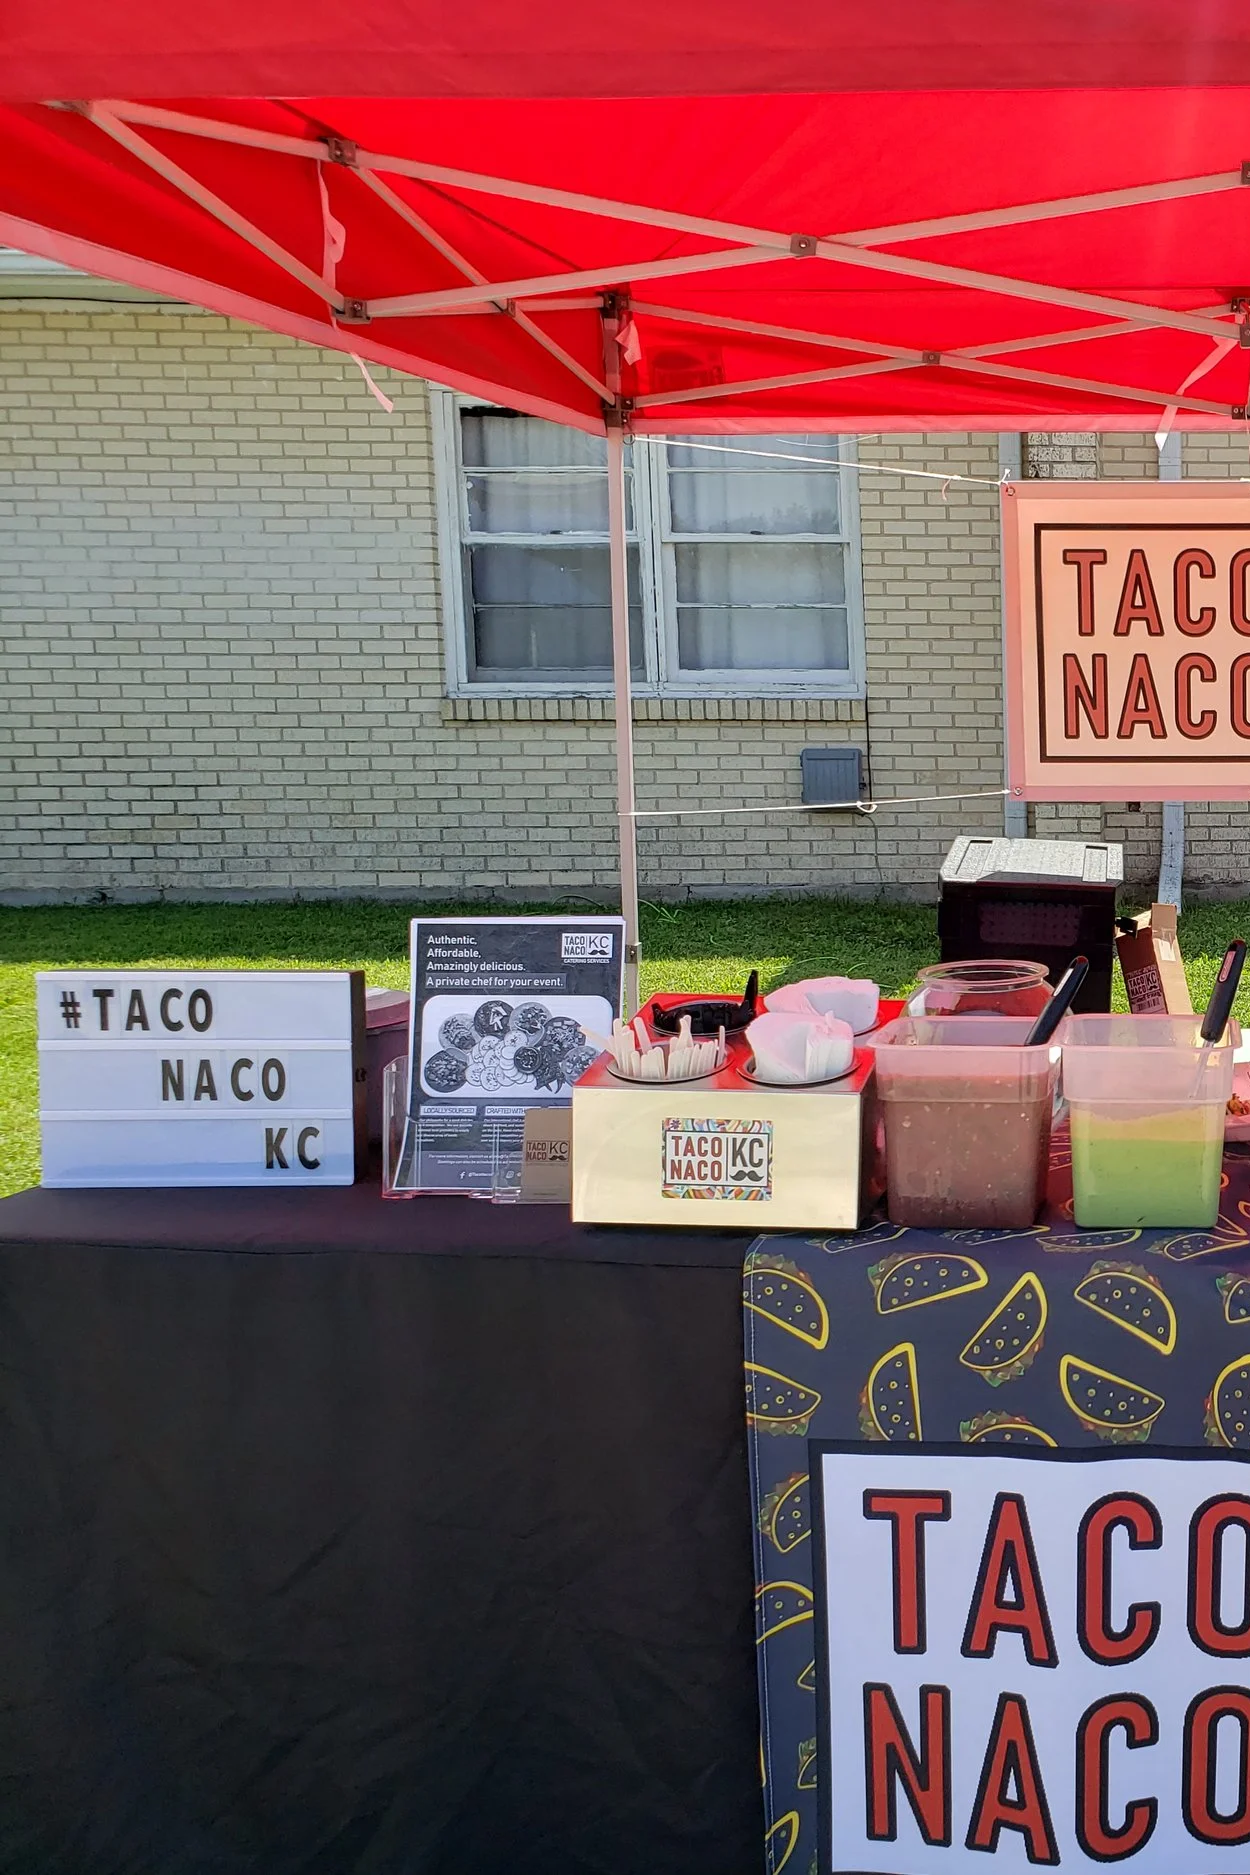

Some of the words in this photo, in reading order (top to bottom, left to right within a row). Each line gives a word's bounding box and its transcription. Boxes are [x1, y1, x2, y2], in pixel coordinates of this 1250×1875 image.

[427, 935, 477, 945] Authentic,
[564, 936, 585, 945] TACO
[589, 936, 609, 949] KC
[427, 948, 481, 959] Affordable,
[564, 946, 586, 955] NACO
[426, 962, 478, 973] Amazingly
[480, 962, 526, 971] delicious.
[426, 978, 434, 986] A
[435, 977, 470, 988] private
[472, 977, 493, 986] chef
[494, 977, 508, 986] for
[510, 978, 532, 988] your
[534, 978, 563, 986] event.
[60, 988, 213, 1031] #TACO
[161, 1057, 286, 1102] NACO
[265, 1126, 321, 1170] KC
[528, 1142, 546, 1151] TACO
[550, 1141, 568, 1154] KC
[672, 1136, 722, 1157] TACO
[732, 1137, 764, 1167] KC
[526, 1152, 547, 1160] NACO
[670, 1159, 722, 1181] NACO
